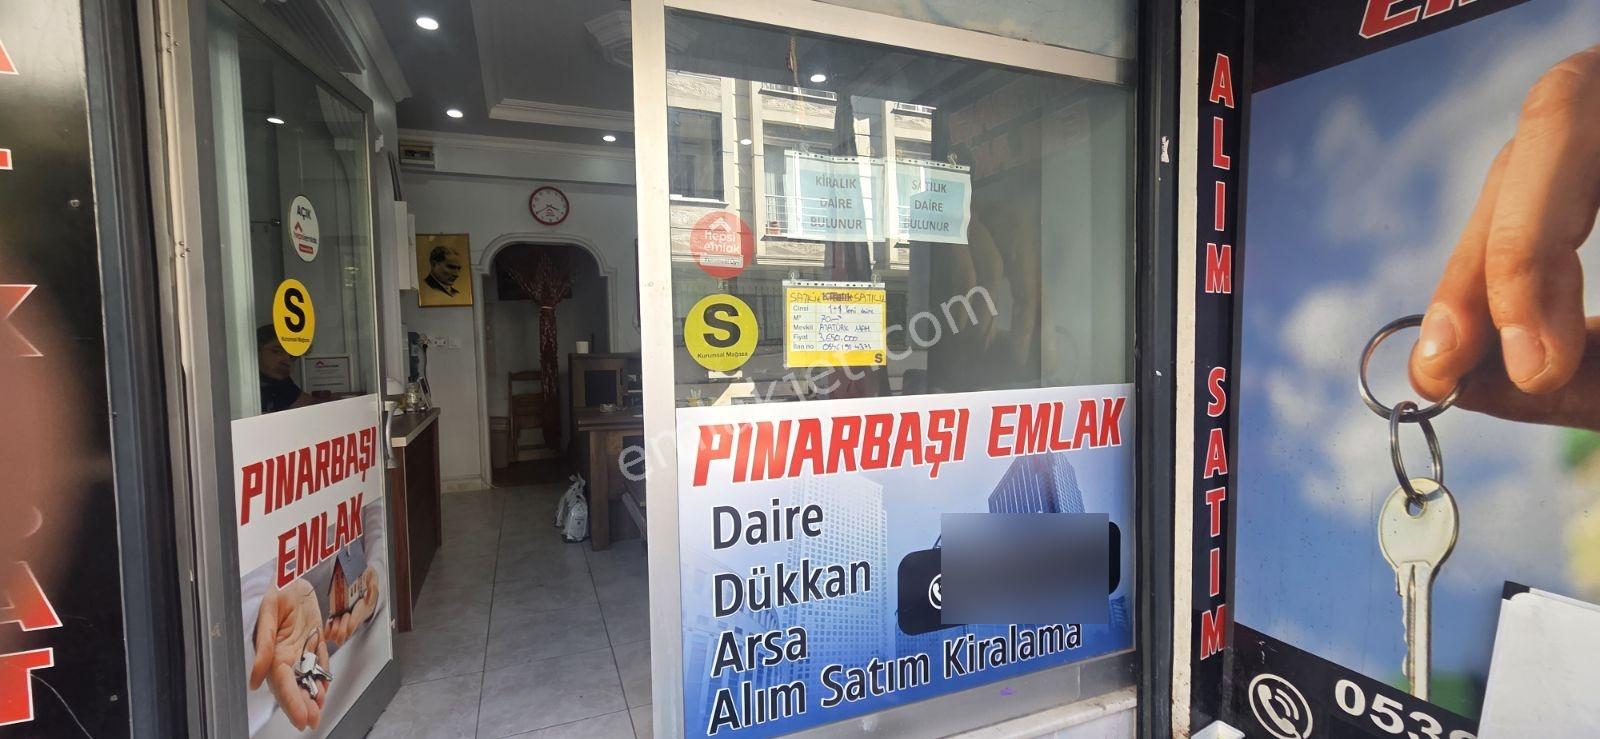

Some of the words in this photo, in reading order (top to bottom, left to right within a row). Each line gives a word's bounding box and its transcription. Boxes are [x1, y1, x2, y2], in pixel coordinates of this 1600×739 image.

[815, 174, 857, 189] KİRALIK
[1205, 52, 1235, 296] ALIM
[810, 217, 863, 230] BULUNUR
[914, 199, 944, 212] DAİRE
[284, 288, 306, 333] S
[702, 303, 741, 348] S
[697, 351, 724, 359] Kurumsal
[692, 408, 969, 486] PINARBAŞI
[987, 397, 1127, 458] EMLAK
[240, 425, 377, 527] PINARBAŞI
[276, 491, 364, 589] EMLAK
[711, 498, 824, 551] Daire
[1200, 366, 1227, 661] SATIM
[712, 558, 872, 619] Dükkan
[706, 680, 807, 737] Alım
[820, 651, 931, 708] Satım
[942, 623, 1083, 681] Kiralama
[709, 627, 808, 679] Arsa
[1334, 679, 1477, 739] 053
